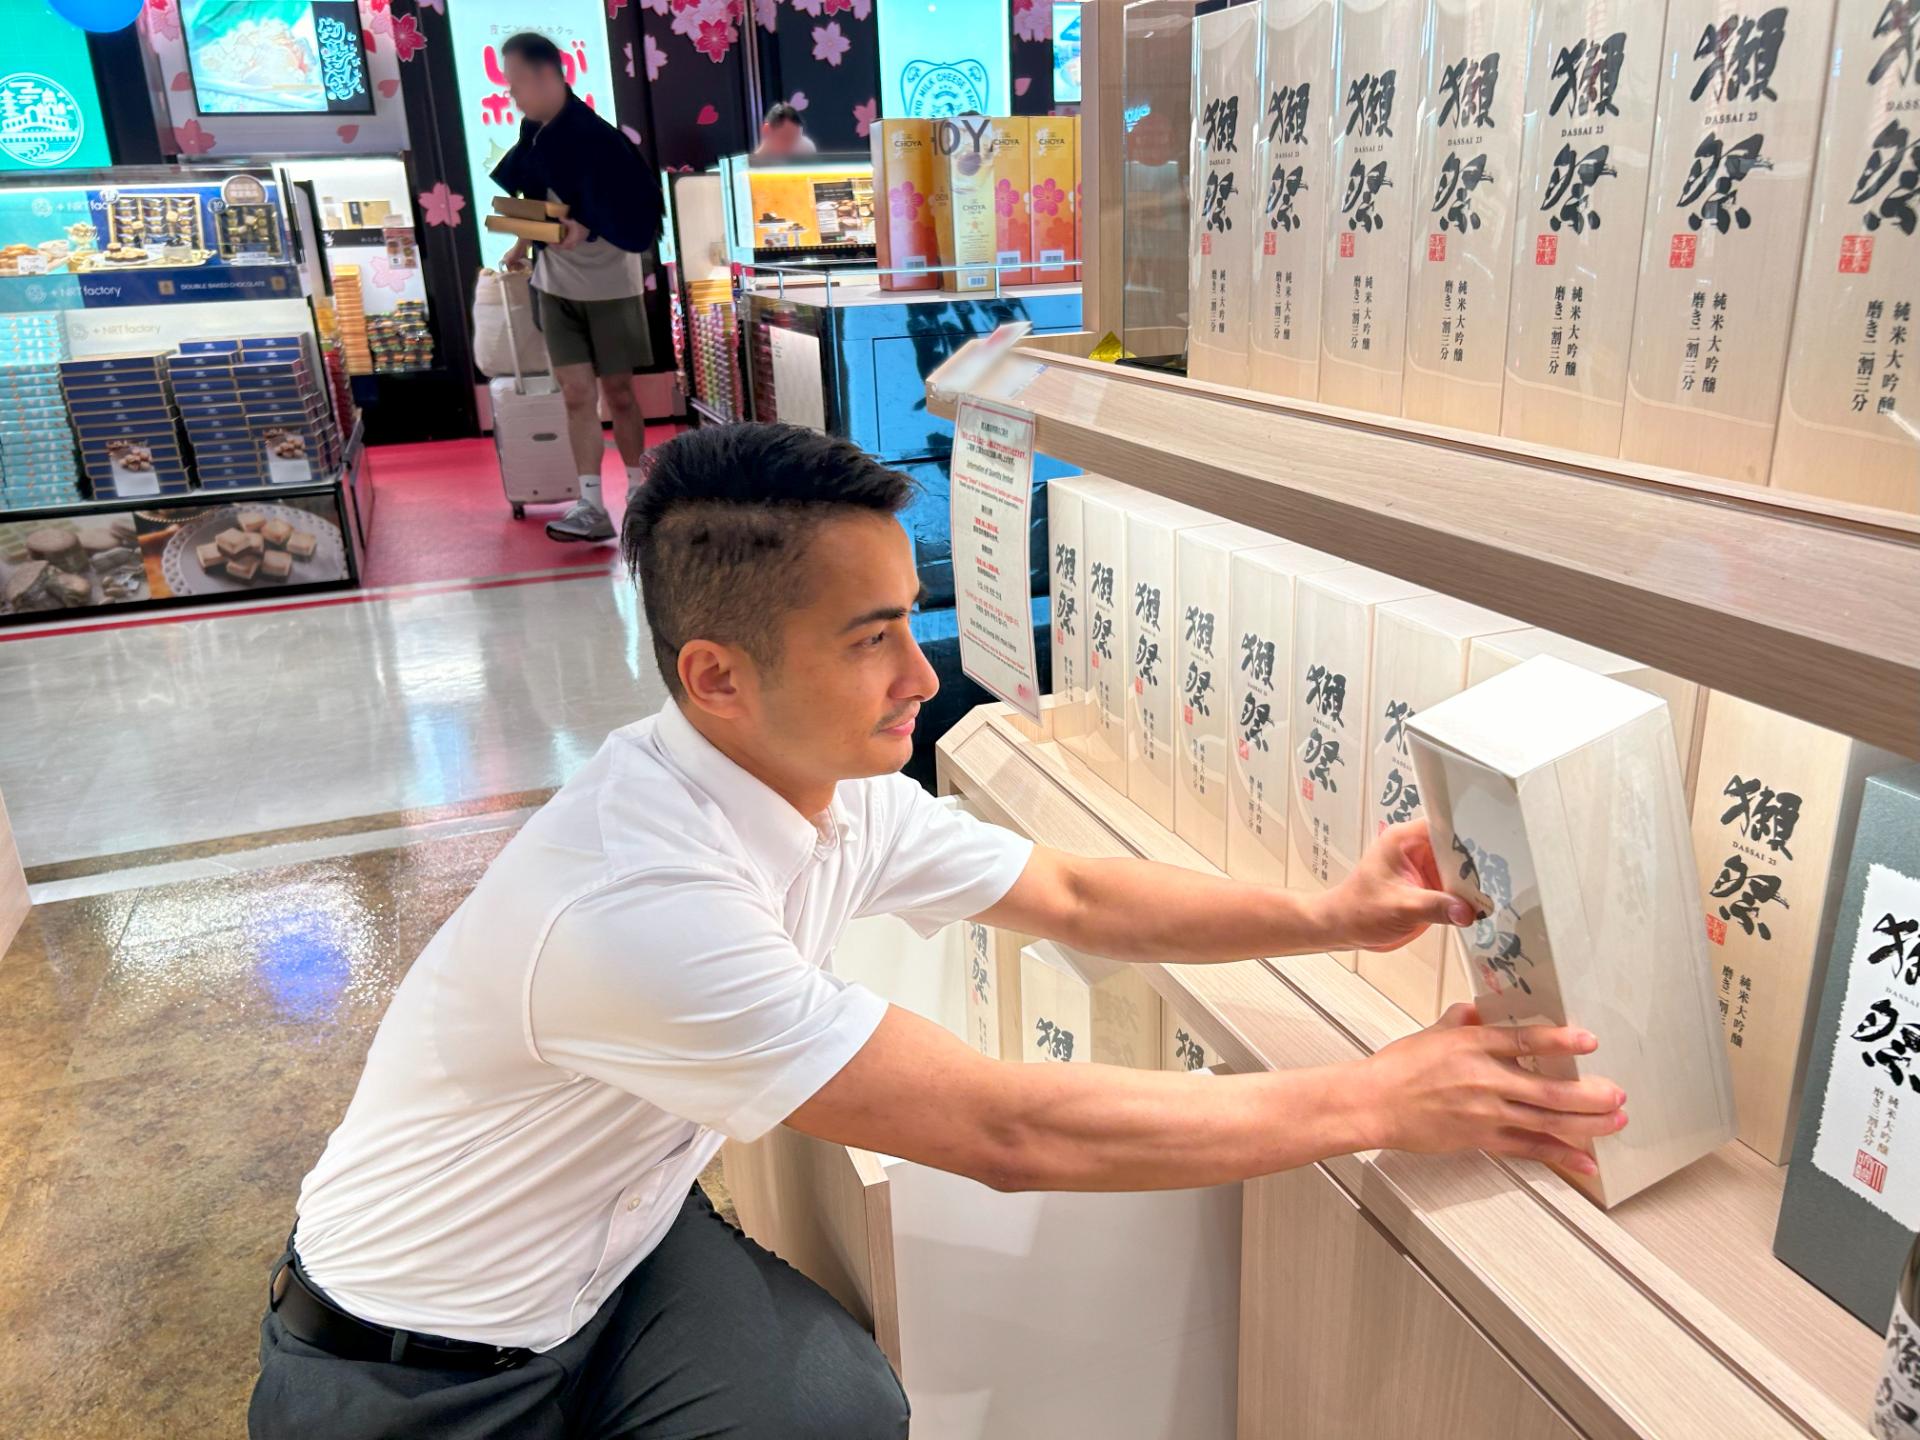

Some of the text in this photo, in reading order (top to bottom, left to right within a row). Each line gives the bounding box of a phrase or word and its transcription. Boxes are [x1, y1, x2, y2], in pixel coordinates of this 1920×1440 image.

[1704, 111, 1758, 126] DASSAI 23
[993, 138, 1019, 146] CHOYA
[1039, 138, 1065, 146] CHOYA
[1447, 135, 1483, 147] DASSAI 23
[1561, 125, 1604, 138] DASSAI 23
[1354, 146, 1375, 154] DASSAI
[83, 285, 122, 298] factory
[180, 281, 206, 290] DOUBLE
[229, 280, 265, 289] CHOCOLATE
[1283, 271, 1292, 341] 純米大吟醸
[1362, 276, 1373, 351] 純米大吟醸
[124, 322, 161, 335] factory
[1453, 280, 1468, 362] 純米大吟醸
[1565, 286, 1583, 377] 純米大吟醸
[1702, 292, 1727, 394] 純米大吟醸
[1852, 300, 1885, 412] 磨き二割三分
[1876, 301, 1911, 415] 純米大吟醸
[1732, 841, 1777, 866] DASSAI 23
[1885, 986, 1920, 1009] DASSAI
[1730, 974, 1752, 1049] 純米大吟醸
[1877, 1094, 1899, 1157] 純米大吟醸
